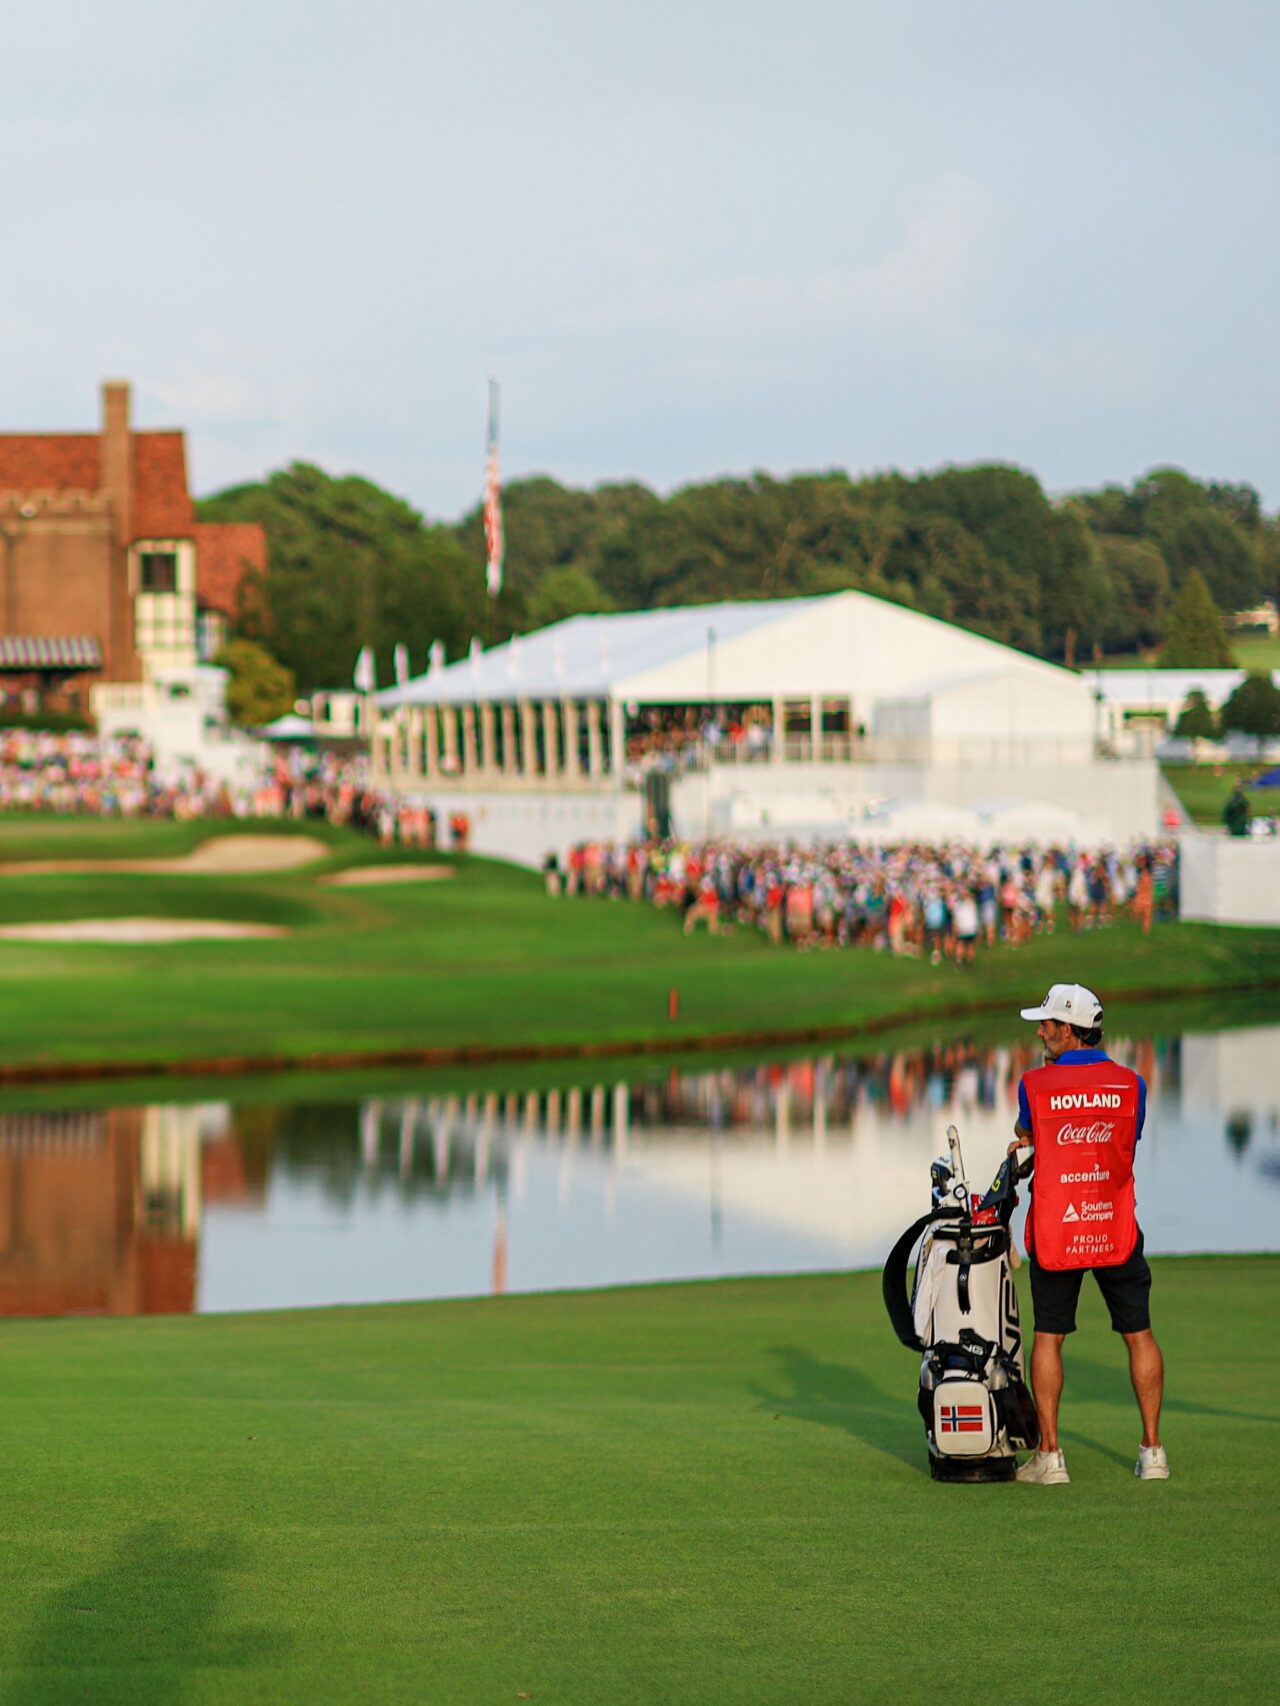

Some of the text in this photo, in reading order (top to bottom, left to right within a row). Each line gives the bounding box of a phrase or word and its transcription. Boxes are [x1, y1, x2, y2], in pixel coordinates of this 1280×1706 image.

[1050, 1094, 1121, 1110] HOVLAND
[1057, 1121, 1115, 1145] Coca-Cola
[1060, 1170, 1110, 1183] accenture
[1081, 1201, 1113, 1212] Southern
[1080, 1210, 1114, 1222] Company
[1073, 1233, 1108, 1244] PROUD
[1065, 1243, 1114, 1254] PARTNERS
